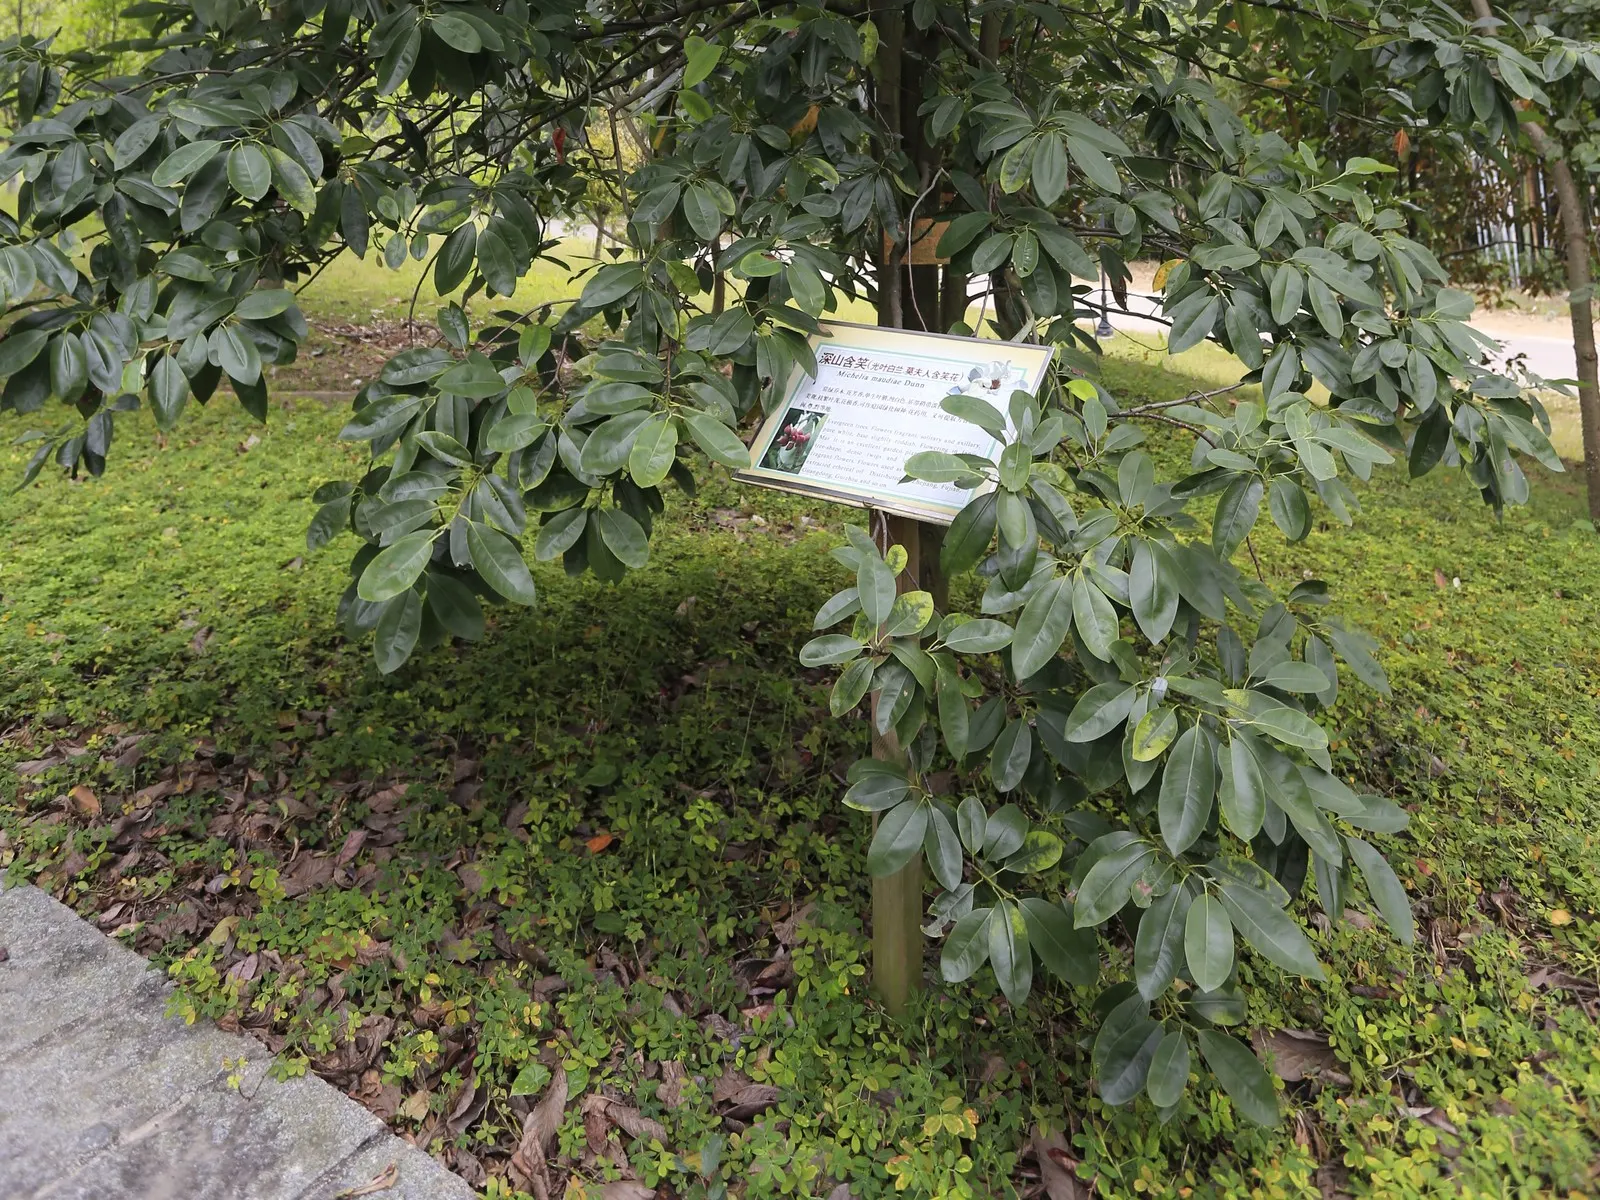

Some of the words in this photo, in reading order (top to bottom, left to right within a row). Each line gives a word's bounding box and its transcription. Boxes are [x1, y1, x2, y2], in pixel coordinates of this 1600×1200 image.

[836, 370, 870, 380] Michelia
[870, 375, 903, 385] maudiae
[903, 380, 926, 388] Dunn
[826, 418, 854, 428] Evergreen
[870, 426, 893, 434] Flowers
[809, 451, 833, 460] fragrant
